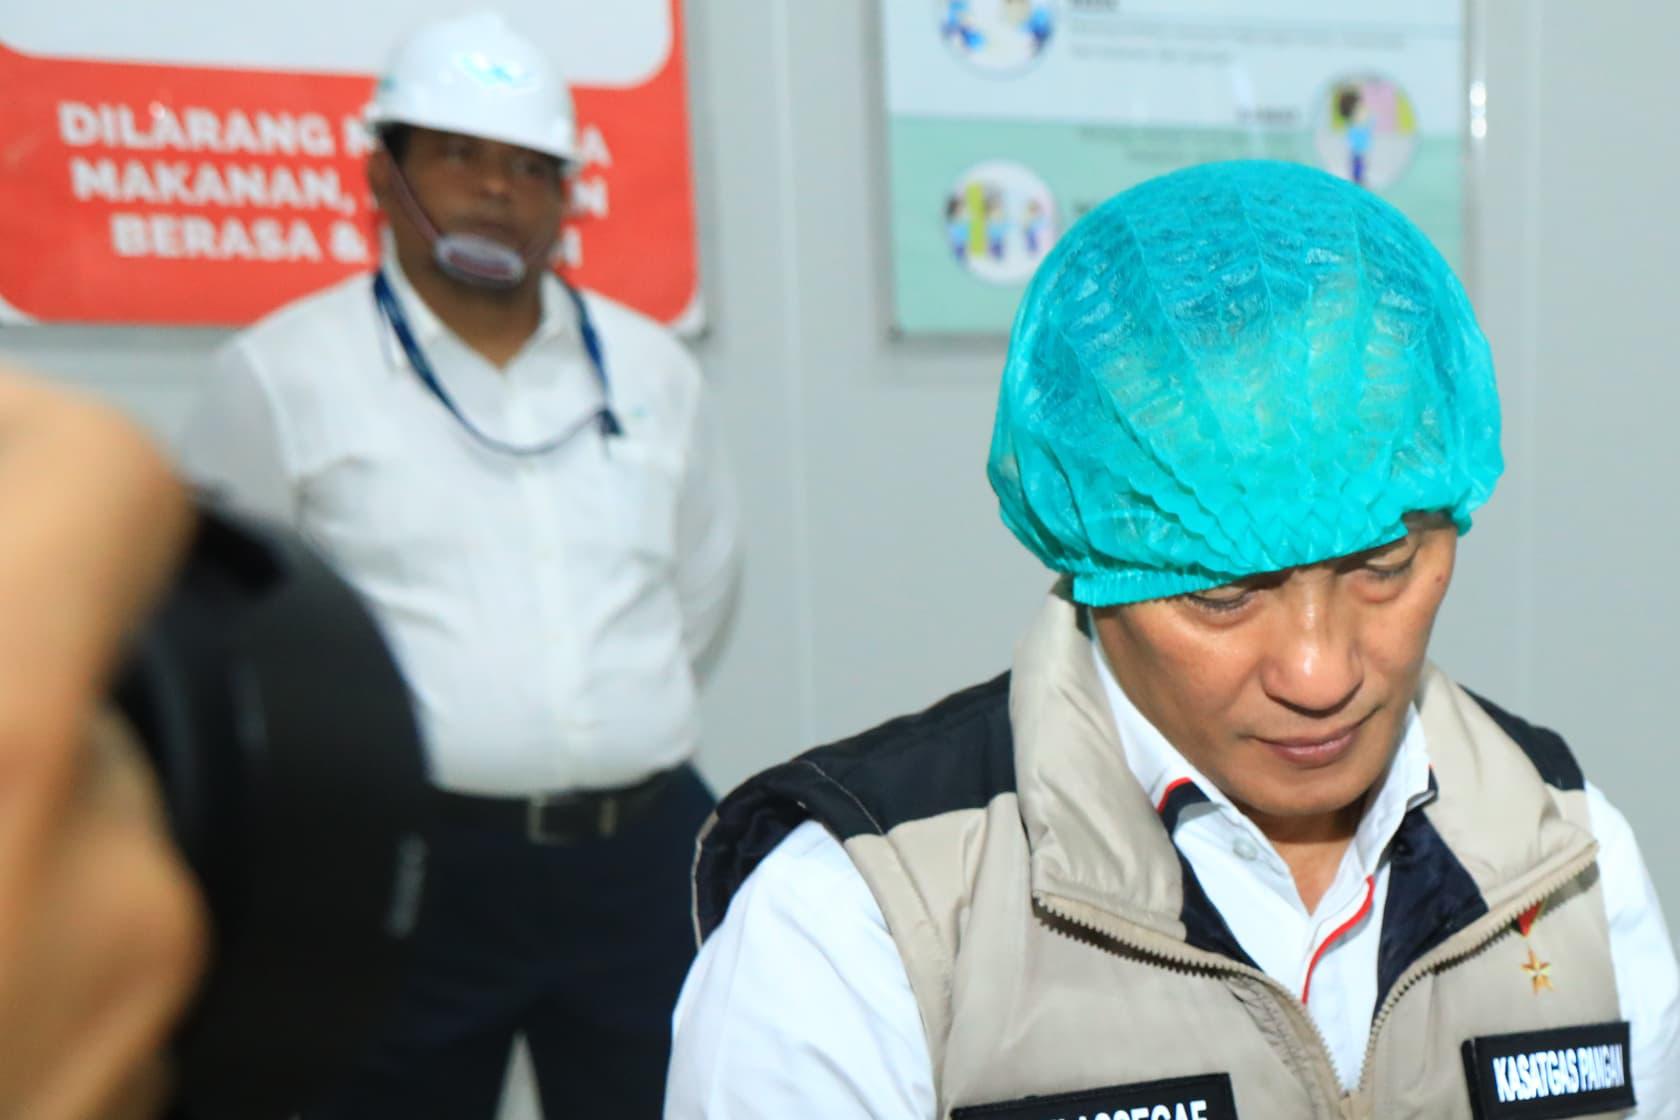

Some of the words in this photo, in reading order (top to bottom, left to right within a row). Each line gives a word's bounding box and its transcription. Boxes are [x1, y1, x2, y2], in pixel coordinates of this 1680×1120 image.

[57, 101, 336, 157] DILARANG
[70, 157, 357, 217] MAKANAN,
[111, 211, 324, 262] BERASA
[329, 218, 369, 263] &
[1493, 1048, 1579, 1102] KASATGAS
